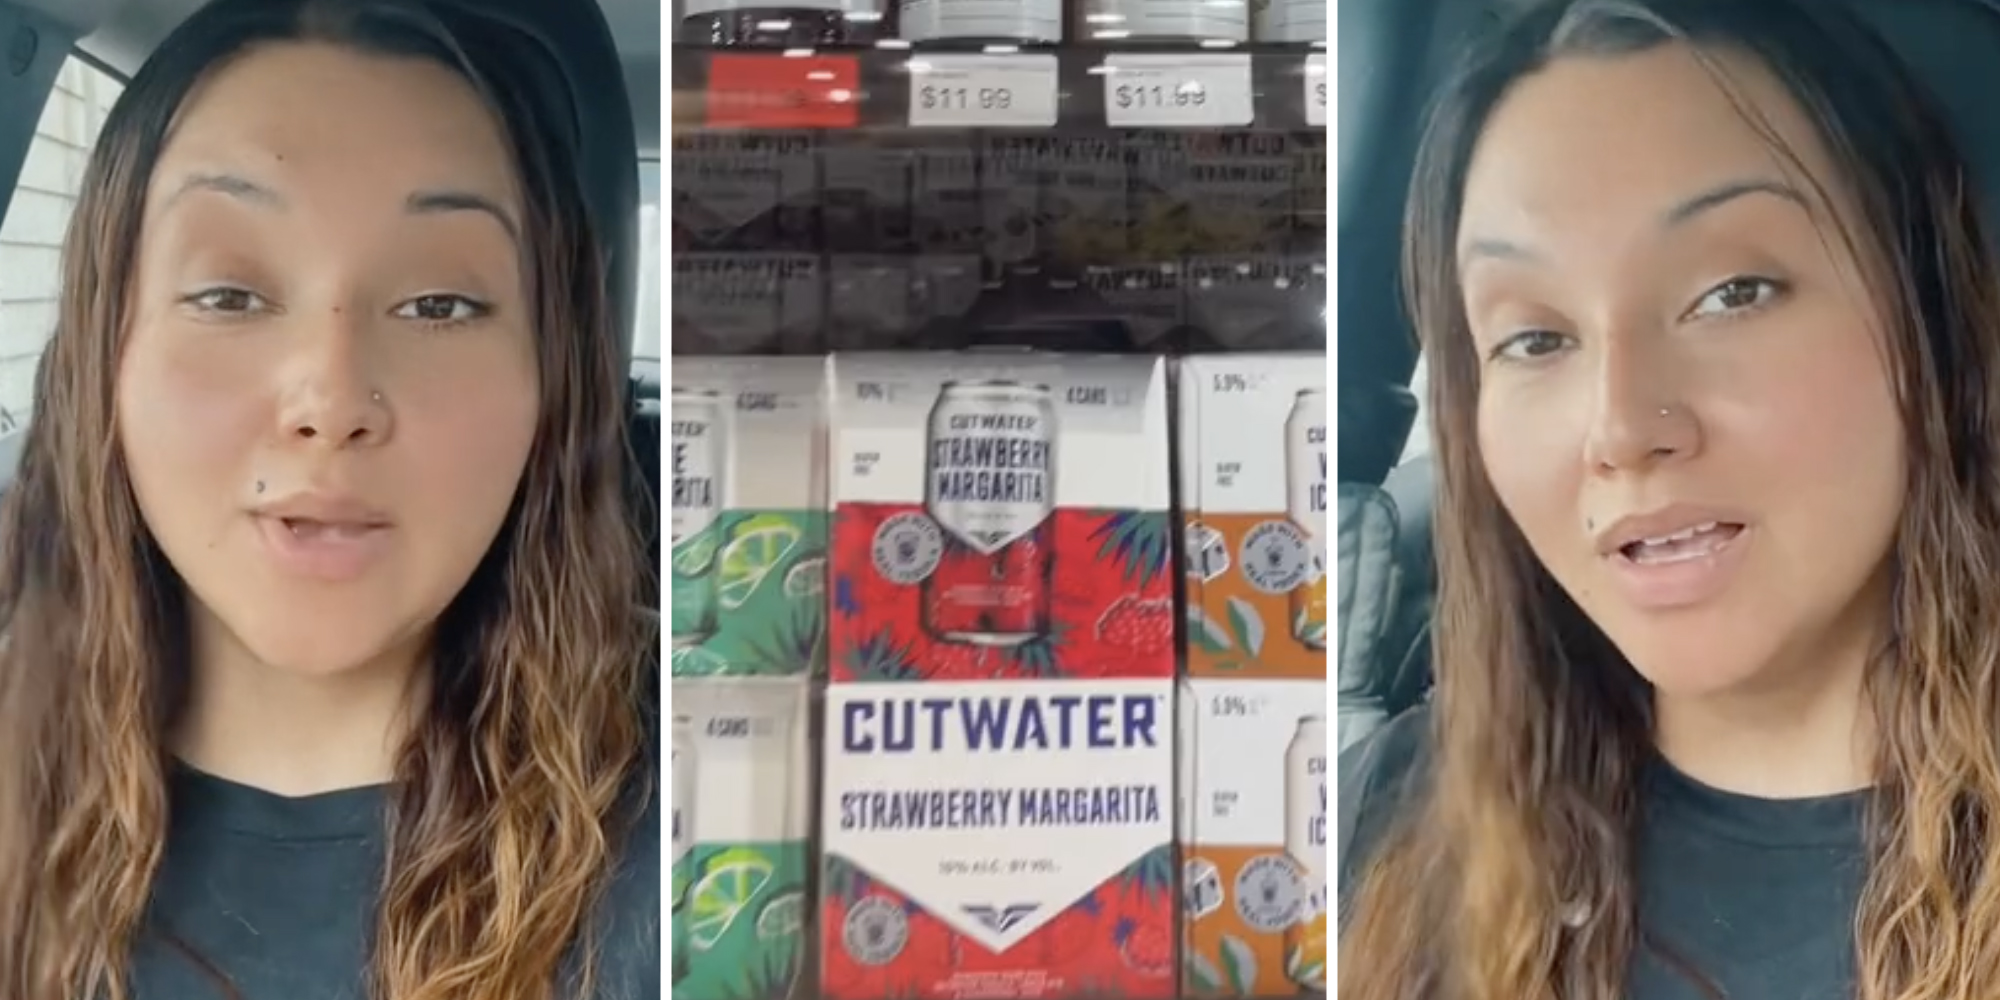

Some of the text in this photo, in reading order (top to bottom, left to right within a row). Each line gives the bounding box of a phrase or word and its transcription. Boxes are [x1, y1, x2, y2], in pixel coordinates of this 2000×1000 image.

[950, 413, 1038, 430] CUTWATER
[933, 437, 1050, 469] STRAWBERRY
[938, 471, 1044, 503] MARGARITA
[843, 694, 1158, 752] CUTWATER
[840, 785, 1159, 831] STRAWBERRY MARGARITA
